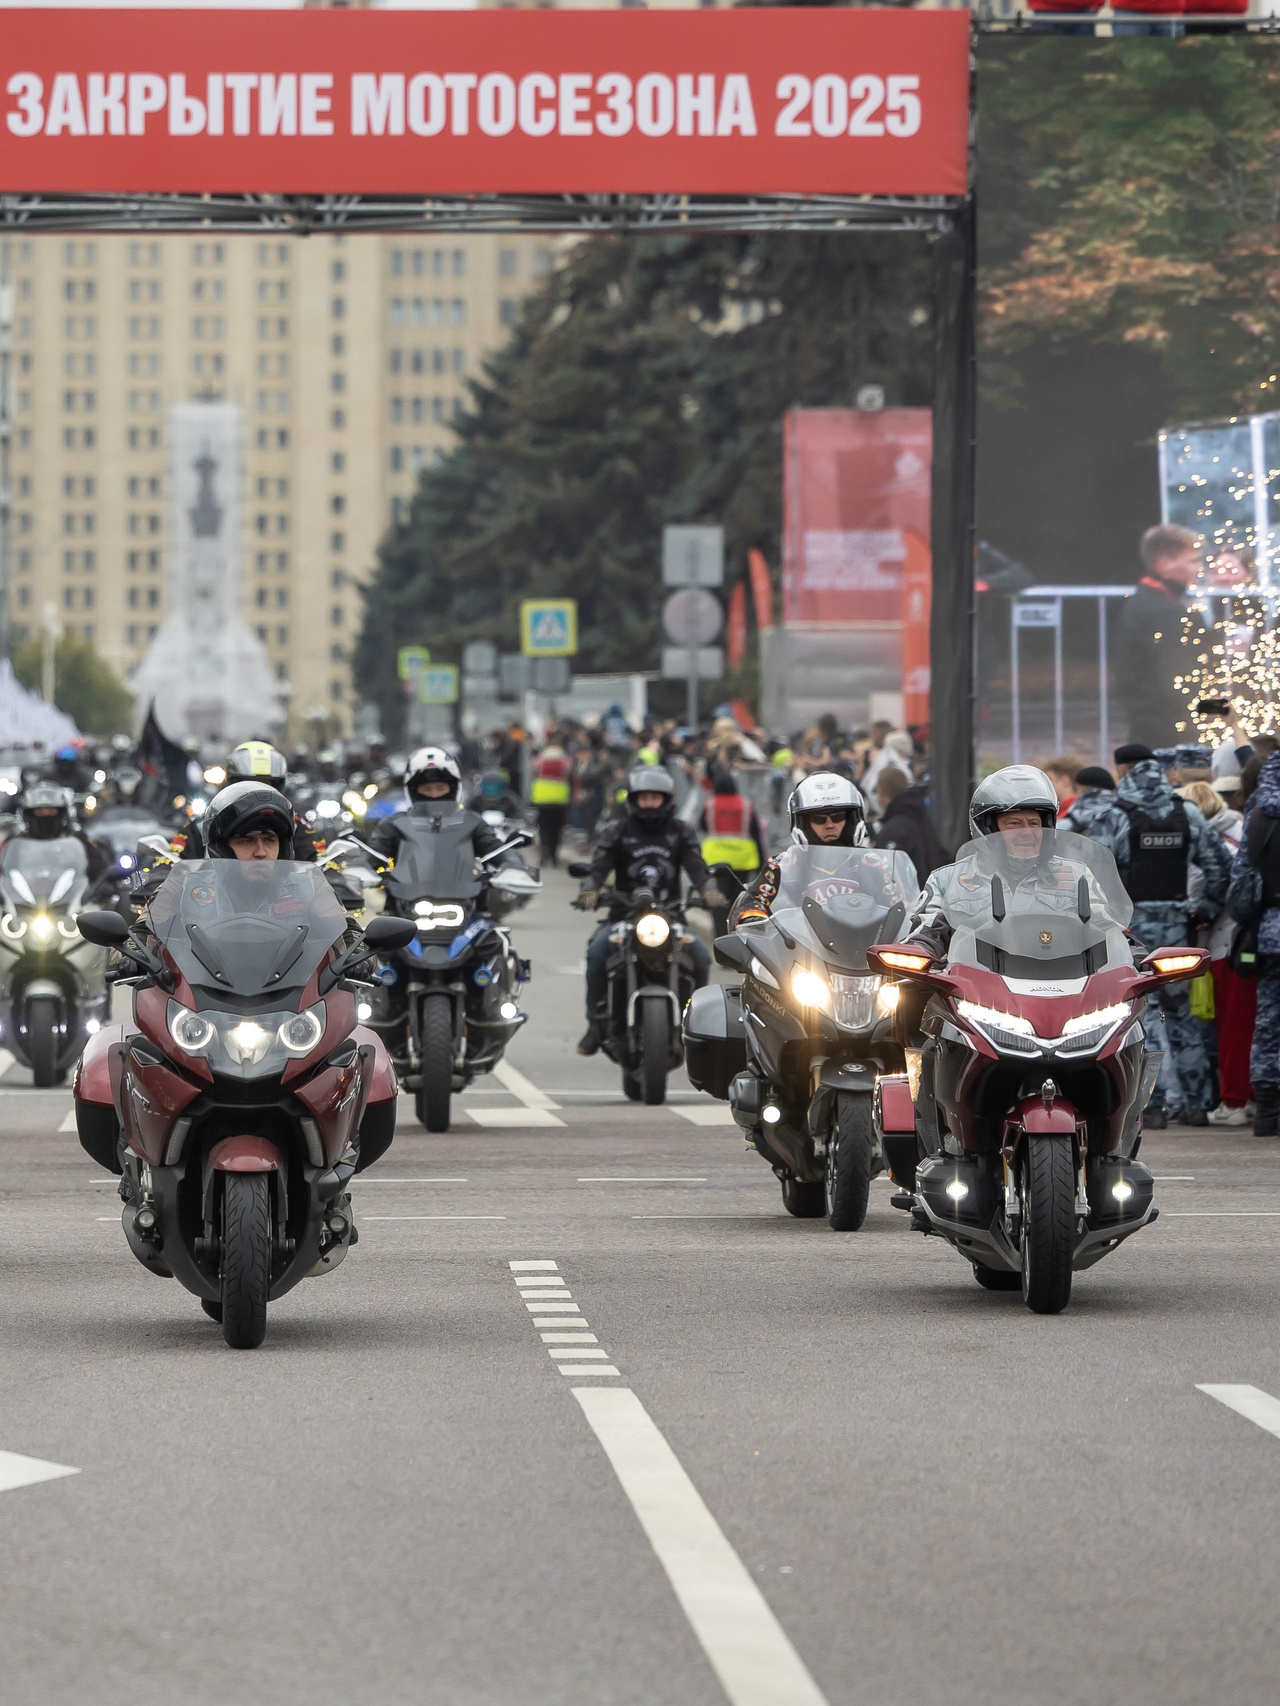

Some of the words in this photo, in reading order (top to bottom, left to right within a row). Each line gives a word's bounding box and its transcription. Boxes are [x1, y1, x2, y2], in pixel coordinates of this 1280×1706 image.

[6, 72, 335, 138] ЗАКРЫТИЕ
[350, 73, 759, 137] МОТОСЕЗОНА
[775, 74, 922, 138] 2025
[1143, 836, 1182, 846] ОМОН
